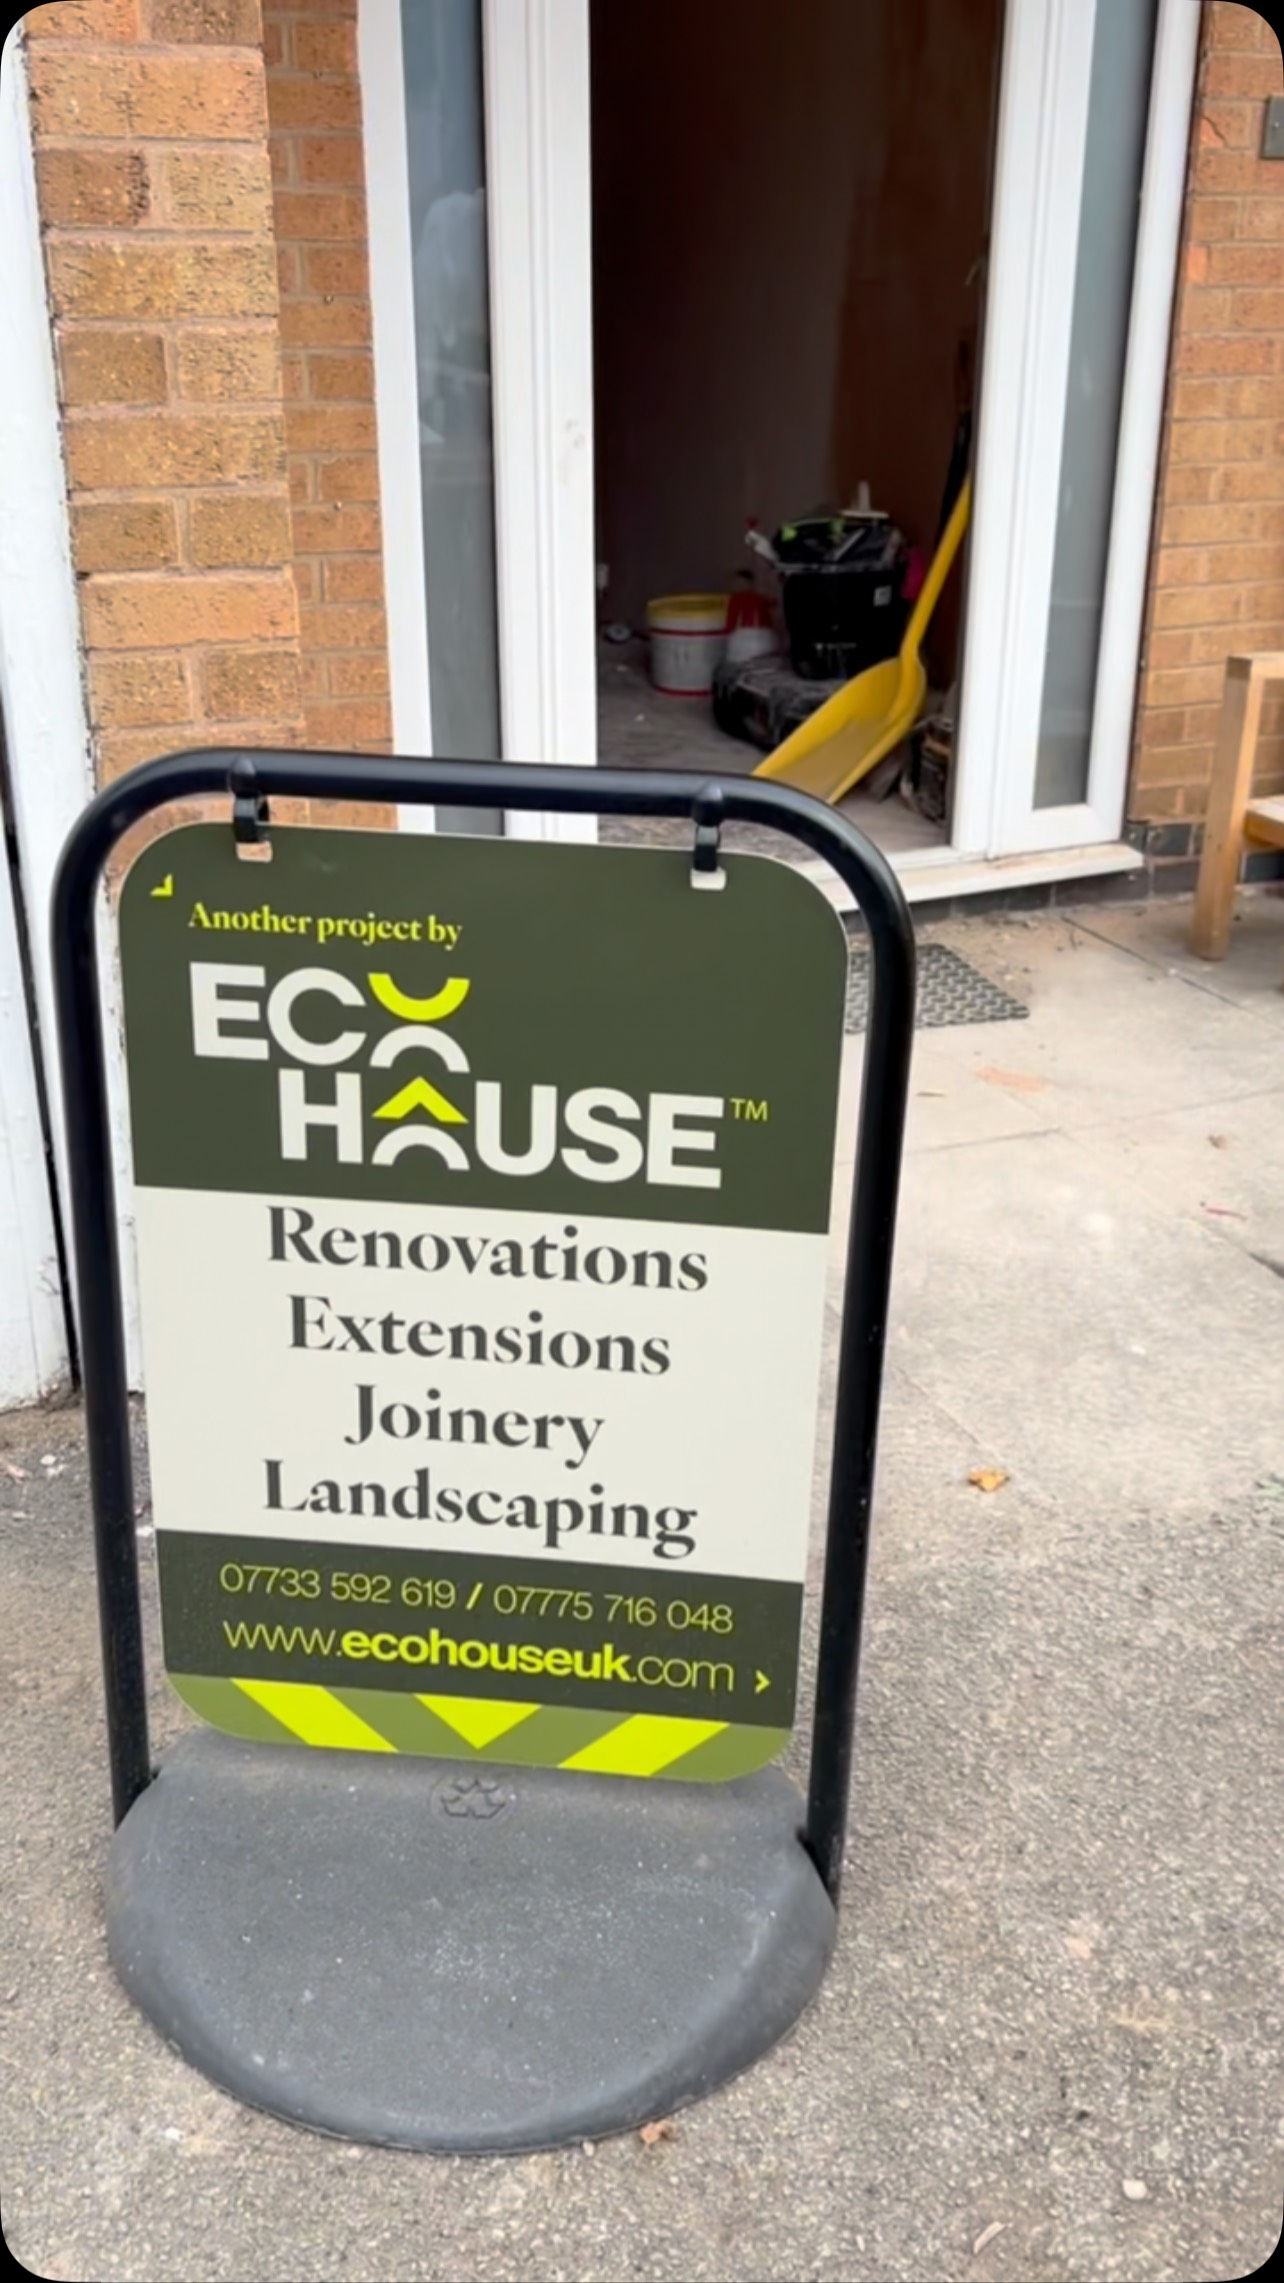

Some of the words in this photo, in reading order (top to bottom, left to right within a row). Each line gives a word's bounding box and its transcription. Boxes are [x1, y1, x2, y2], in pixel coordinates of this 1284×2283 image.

[189, 902, 312, 936] Another
[317, 910, 422, 947] project
[428, 917, 463, 950] by
[266, 1206, 709, 1292] Renovations
[287, 1294, 672, 1375] Extensions
[344, 1384, 605, 1470] Joinery
[262, 1459, 699, 1560] Landscaping
[219, 1563, 321, 1598] 07733
[331, 1571, 391, 1604] 592
[401, 1579, 456, 1609] 619
[493, 1584, 594, 1621] 07775
[606, 1595, 657, 1627] 716
[666, 1600, 733, 1634] 048
[223, 1620, 735, 1692] www.ecohouseuk.com
